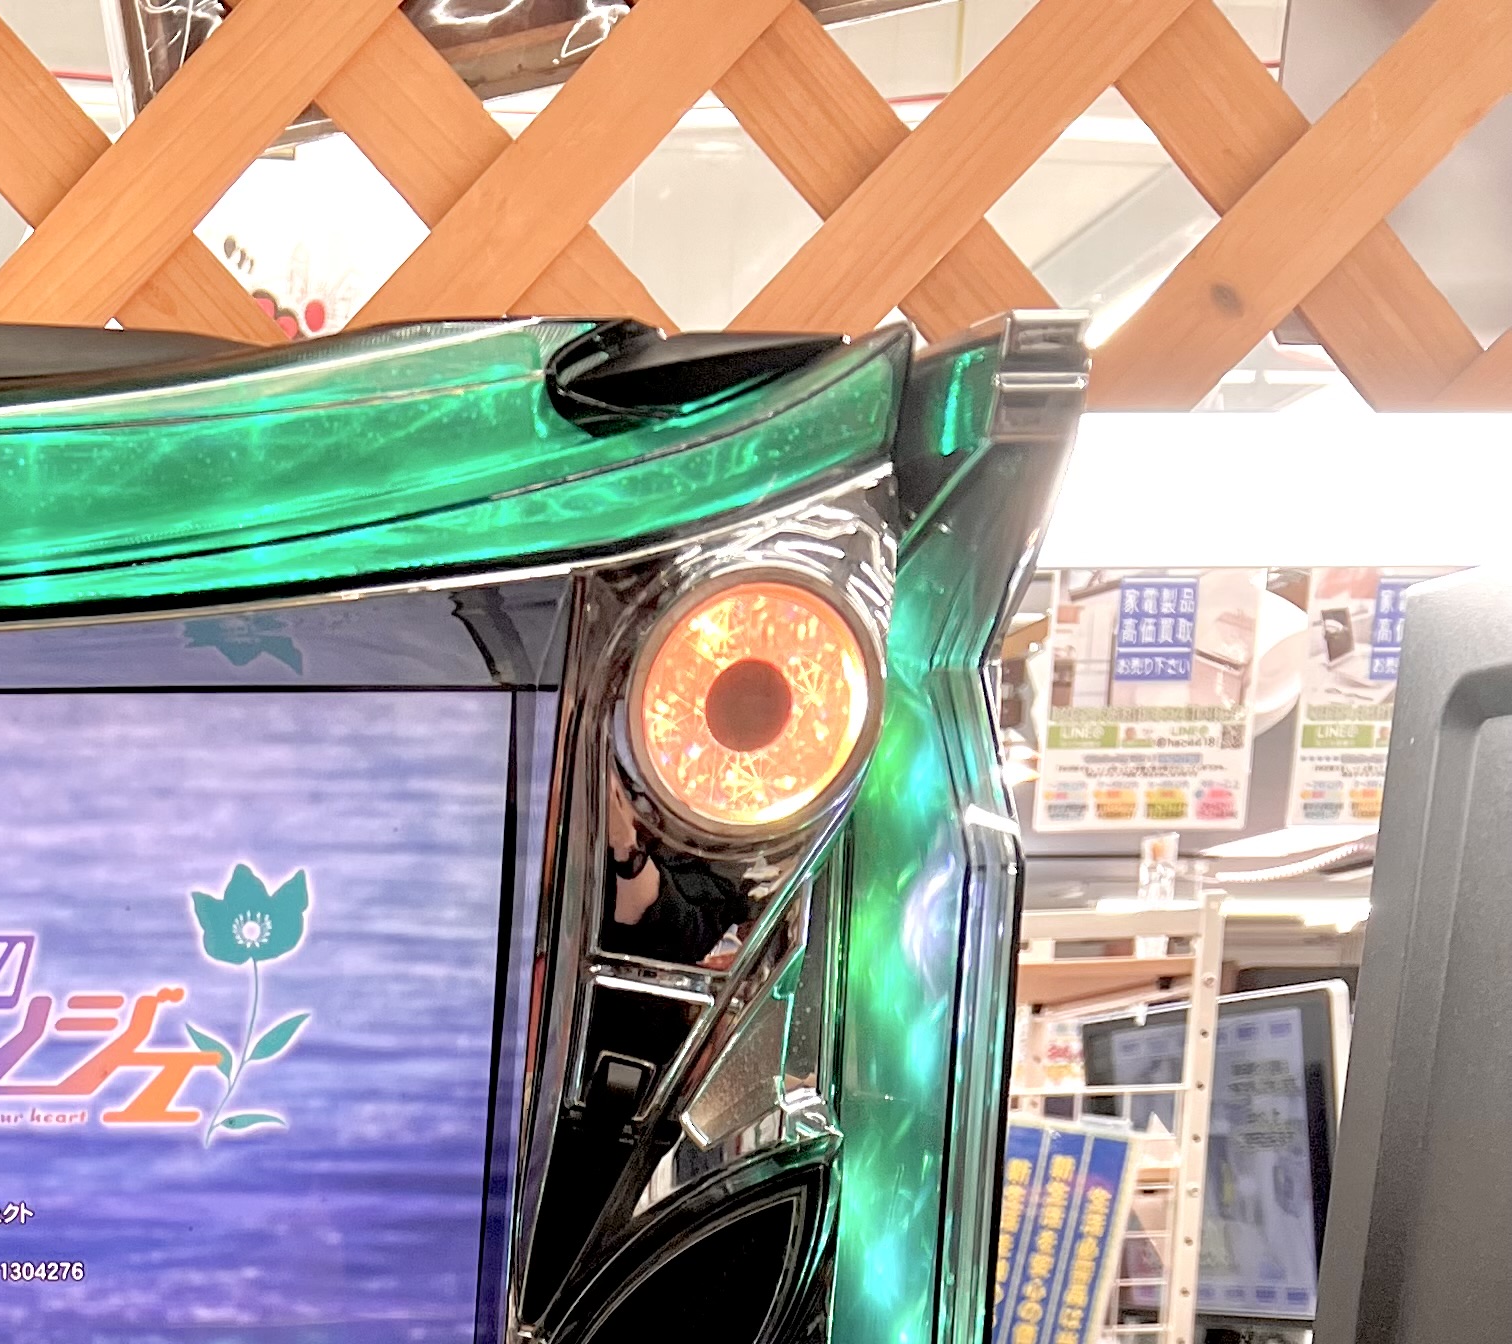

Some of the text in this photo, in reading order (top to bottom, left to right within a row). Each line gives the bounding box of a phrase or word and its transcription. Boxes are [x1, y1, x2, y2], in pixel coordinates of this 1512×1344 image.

[1124, 588, 1195, 614] 家電製品
[1121, 618, 1192, 643] 高価買取
[1116, 657, 1190, 676] お売り下さい
[29, 1109, 87, 1126] heart
